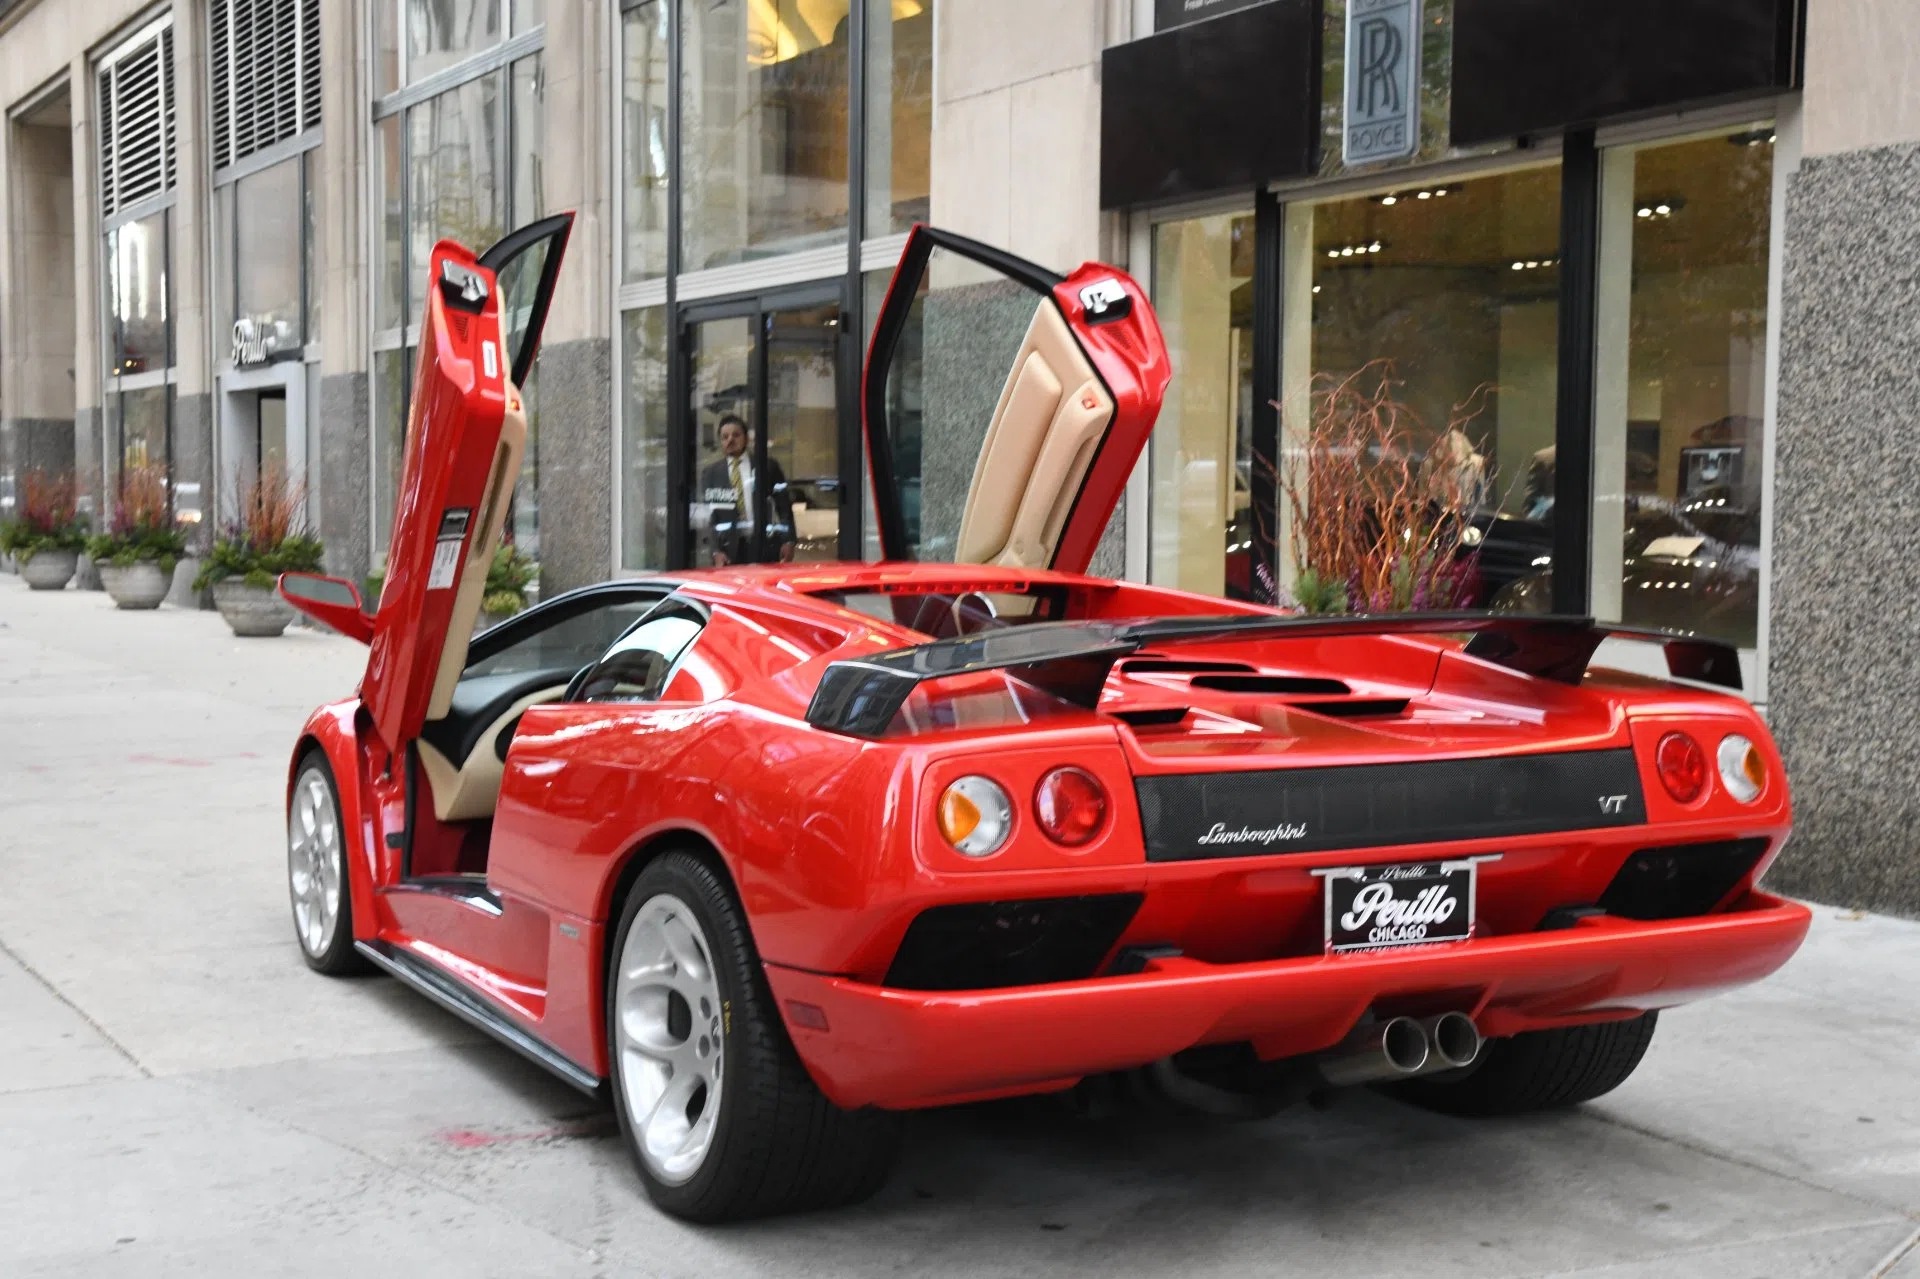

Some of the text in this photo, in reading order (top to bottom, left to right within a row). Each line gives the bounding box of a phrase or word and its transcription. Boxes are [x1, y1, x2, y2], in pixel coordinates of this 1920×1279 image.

[1350, 123, 1403, 150] ROYCE
[231, 318, 268, 367] Perillo
[704, 487, 739, 502] ENTRANCE
[1598, 794, 1628, 815] VT
[1197, 822, 1307, 846] Lamborghini
[1378, 864, 1428, 881] Perillo
[1340, 882, 1458, 932] Perillo
[1368, 923, 1428, 944] CHICAGO
